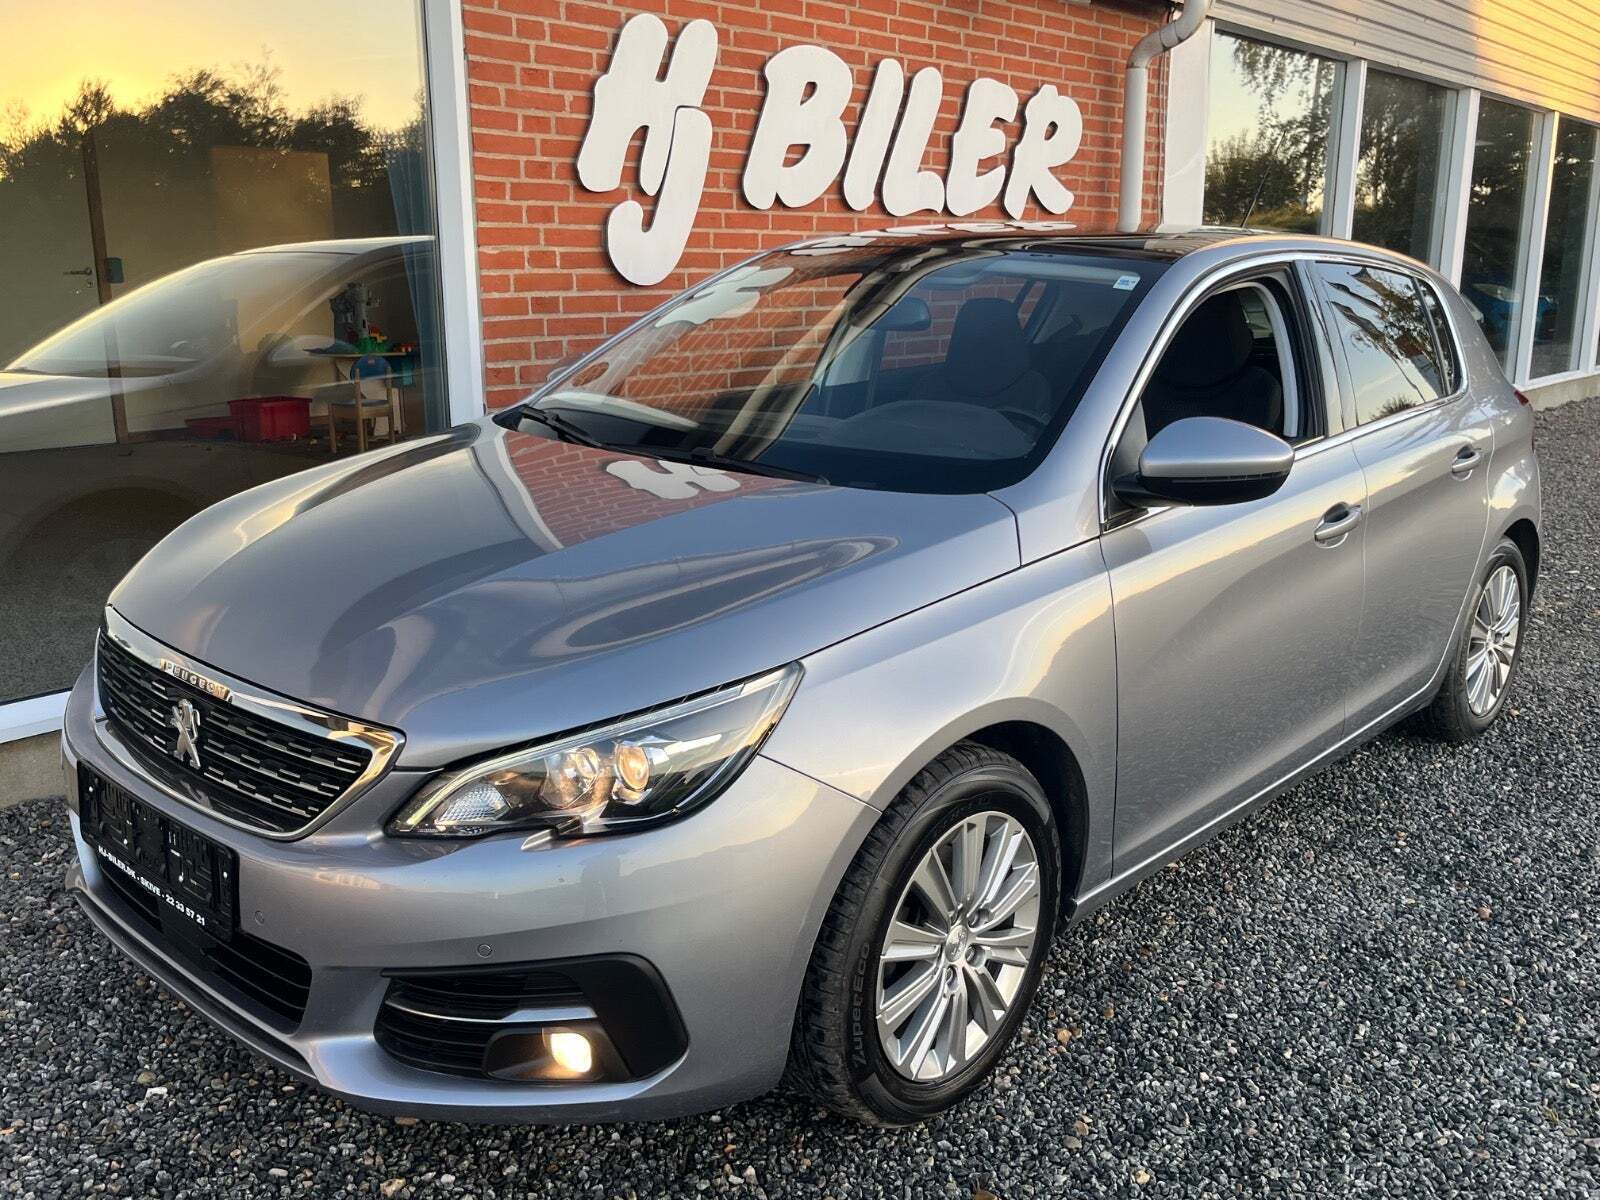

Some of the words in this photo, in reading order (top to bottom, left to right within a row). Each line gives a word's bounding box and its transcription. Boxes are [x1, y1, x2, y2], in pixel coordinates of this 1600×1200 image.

[577, 13, 719, 286] HJ
[743, 45, 1083, 220] BILER
[164, 661, 227, 699] PEUGEOT
[140, 876, 161, 897] SKIVE
[165, 894, 176, 907] 22
[175, 900, 185, 913] 33
[185, 906, 195, 919] 57
[196, 914, 206, 926] 21
